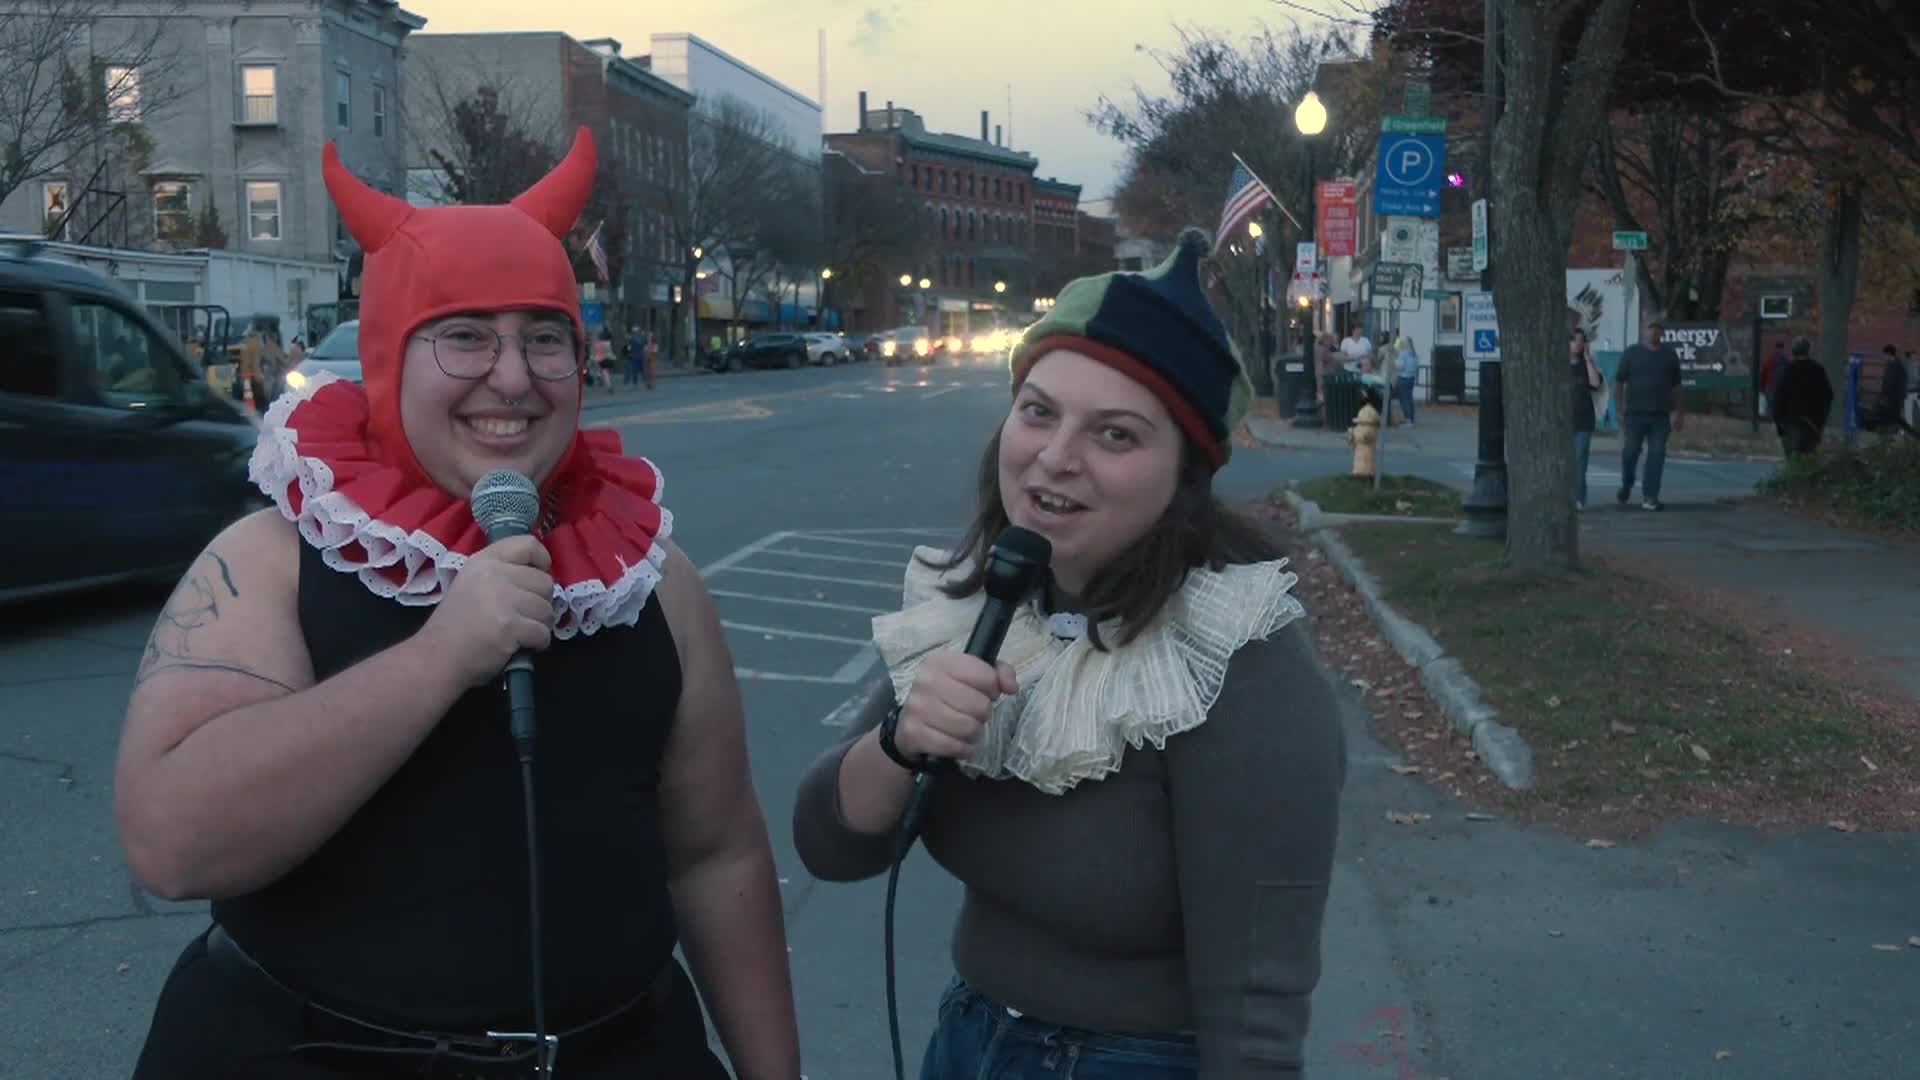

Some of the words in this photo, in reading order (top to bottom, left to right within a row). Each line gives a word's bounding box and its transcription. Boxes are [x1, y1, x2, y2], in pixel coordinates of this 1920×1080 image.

[1401, 151, 1421, 174] P
[1660, 329, 1719, 347] nergy
[1675, 343, 1696, 360] rk
